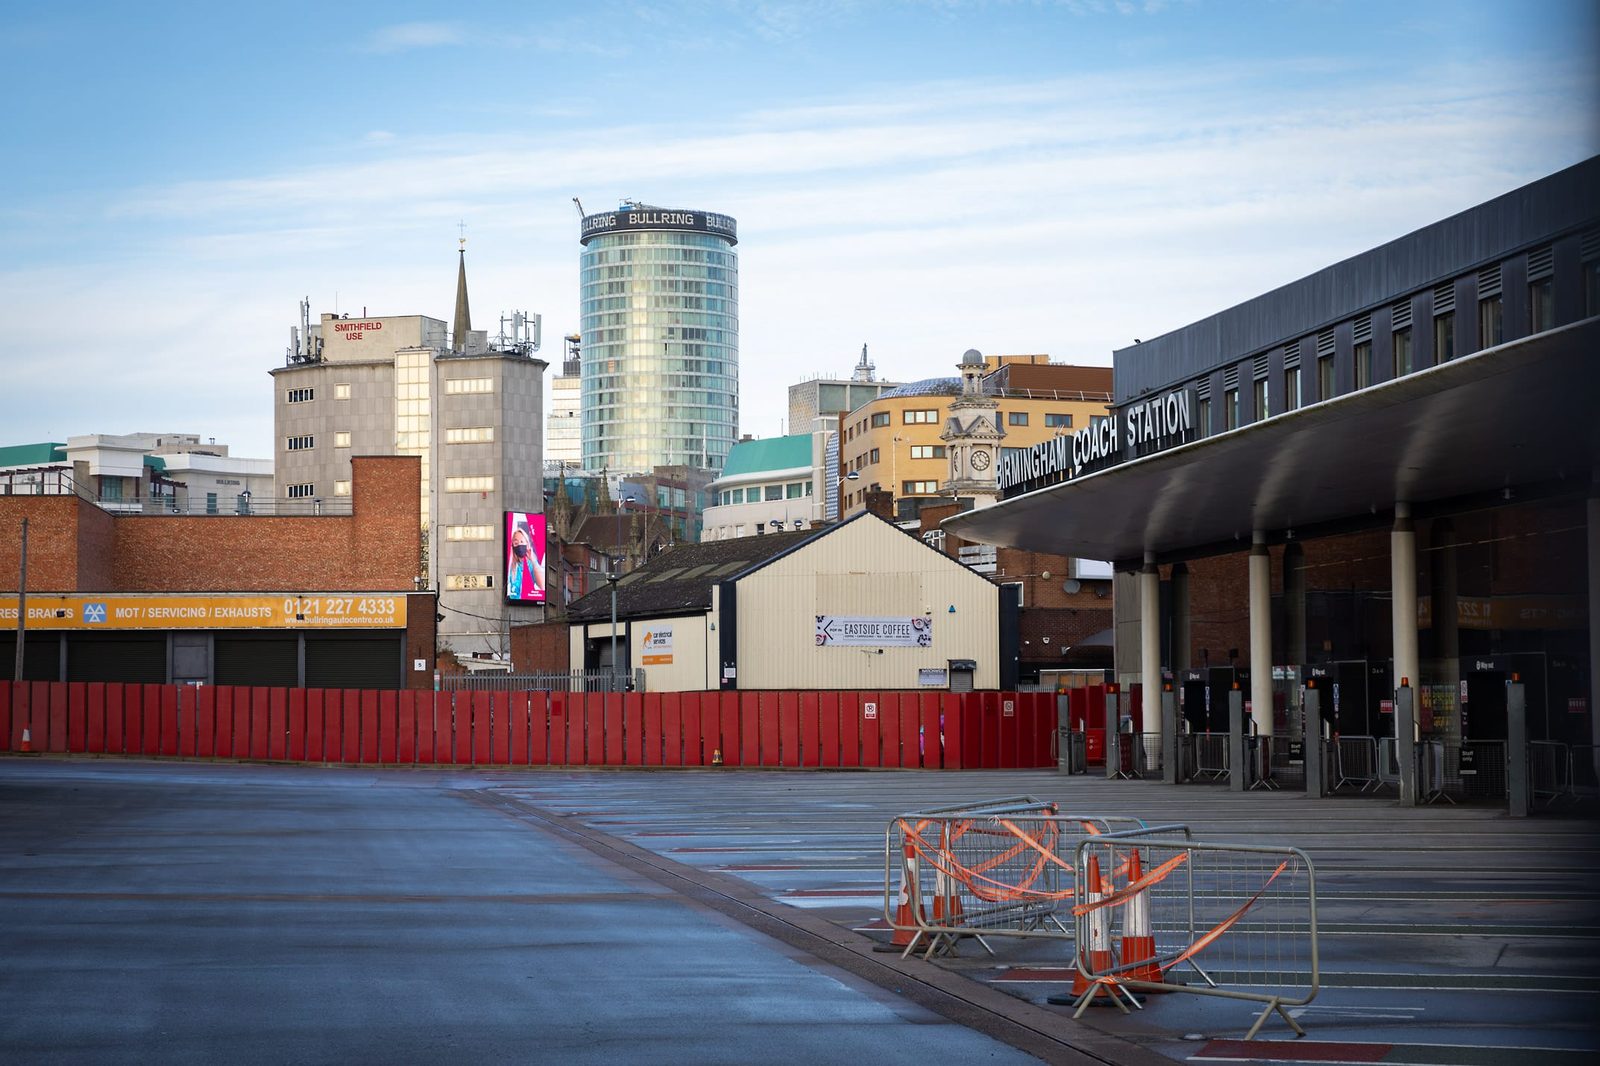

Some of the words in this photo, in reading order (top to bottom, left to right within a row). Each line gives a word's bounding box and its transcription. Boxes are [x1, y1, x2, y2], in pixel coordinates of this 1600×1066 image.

[629, 213, 694, 225] BULLRING
[334, 322, 382, 332] SMITHFIELD
[346, 332, 363, 341] USE
[996, 435, 1066, 490] BIRMINGHAM
[1073, 415, 1118, 467] COACH
[1127, 390, 1190, 447] STATION
[284, 599, 320, 614] 0121
[326, 599, 354, 614] 227
[358, 599, 395, 614] 4333
[115, 607, 140, 618] MOT
[141, 607, 146, 618] /
[148, 607, 206, 618] SERVICING
[208, 607, 213, 618] /
[214, 607, 272, 618] EXHAUSTS
[844, 624, 880, 635] EASTSIDE
[882, 624, 910, 635] COFFEE
